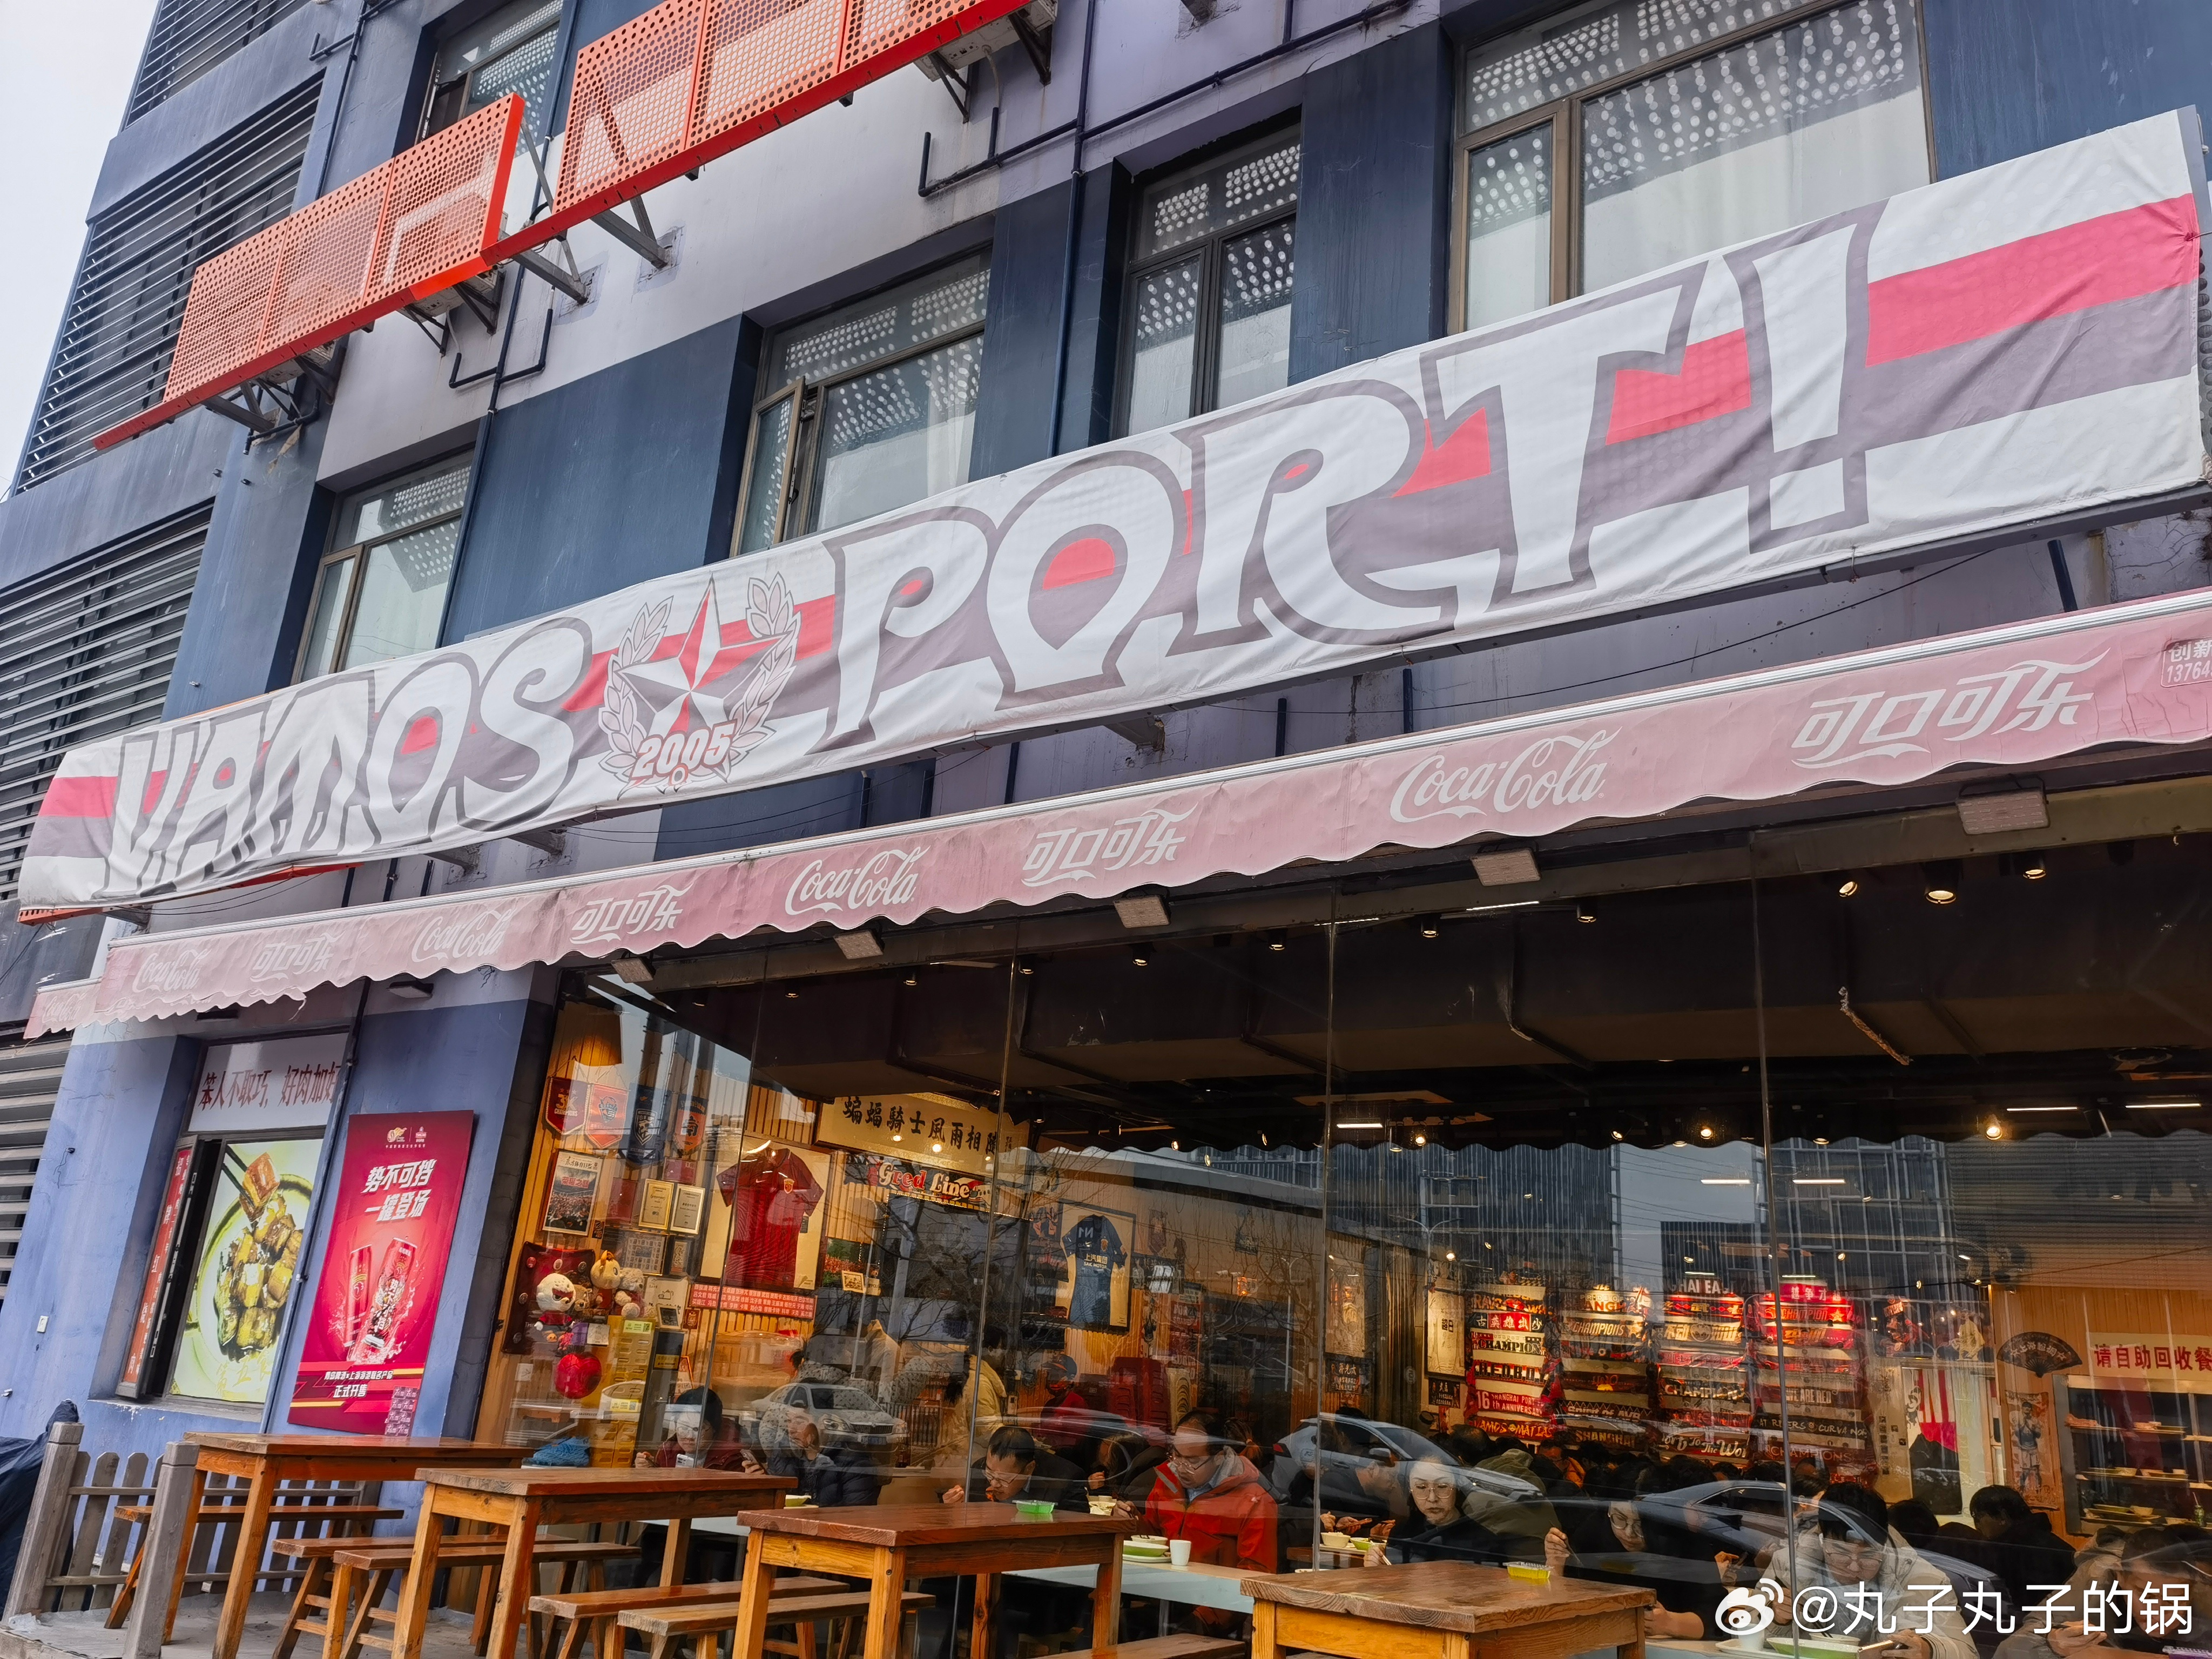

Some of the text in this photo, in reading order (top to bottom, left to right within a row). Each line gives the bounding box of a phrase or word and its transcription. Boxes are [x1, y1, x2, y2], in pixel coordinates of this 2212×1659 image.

[2167, 660, 2212, 683] 13764
[1791, 648, 2112, 769] 可口可乐
[96, 617, 593, 898] VAMOS
[632, 720, 736, 776] 2005
[1389, 725, 1623, 823] Coca-Cola
[1021, 803, 1199, 887] 可口可乐
[785, 845, 930, 916] Coca-Cola
[412, 908, 517, 963] Coca-Cola
[570, 881, 694, 945] 可口可乐
[361, 1158, 437, 1194] 势不可挡
[364, 1189, 432, 1222] 一罐登场
[1573, 1321, 1626, 1336] CHAMPIONS
[2094, 1343, 2212, 1372] 请自助回收餐
[333, 1384, 368, 1398] 正式开售
[1476, 1391, 1490, 1409] 16
[1575, 1430, 1636, 1448] SHANGHAI
